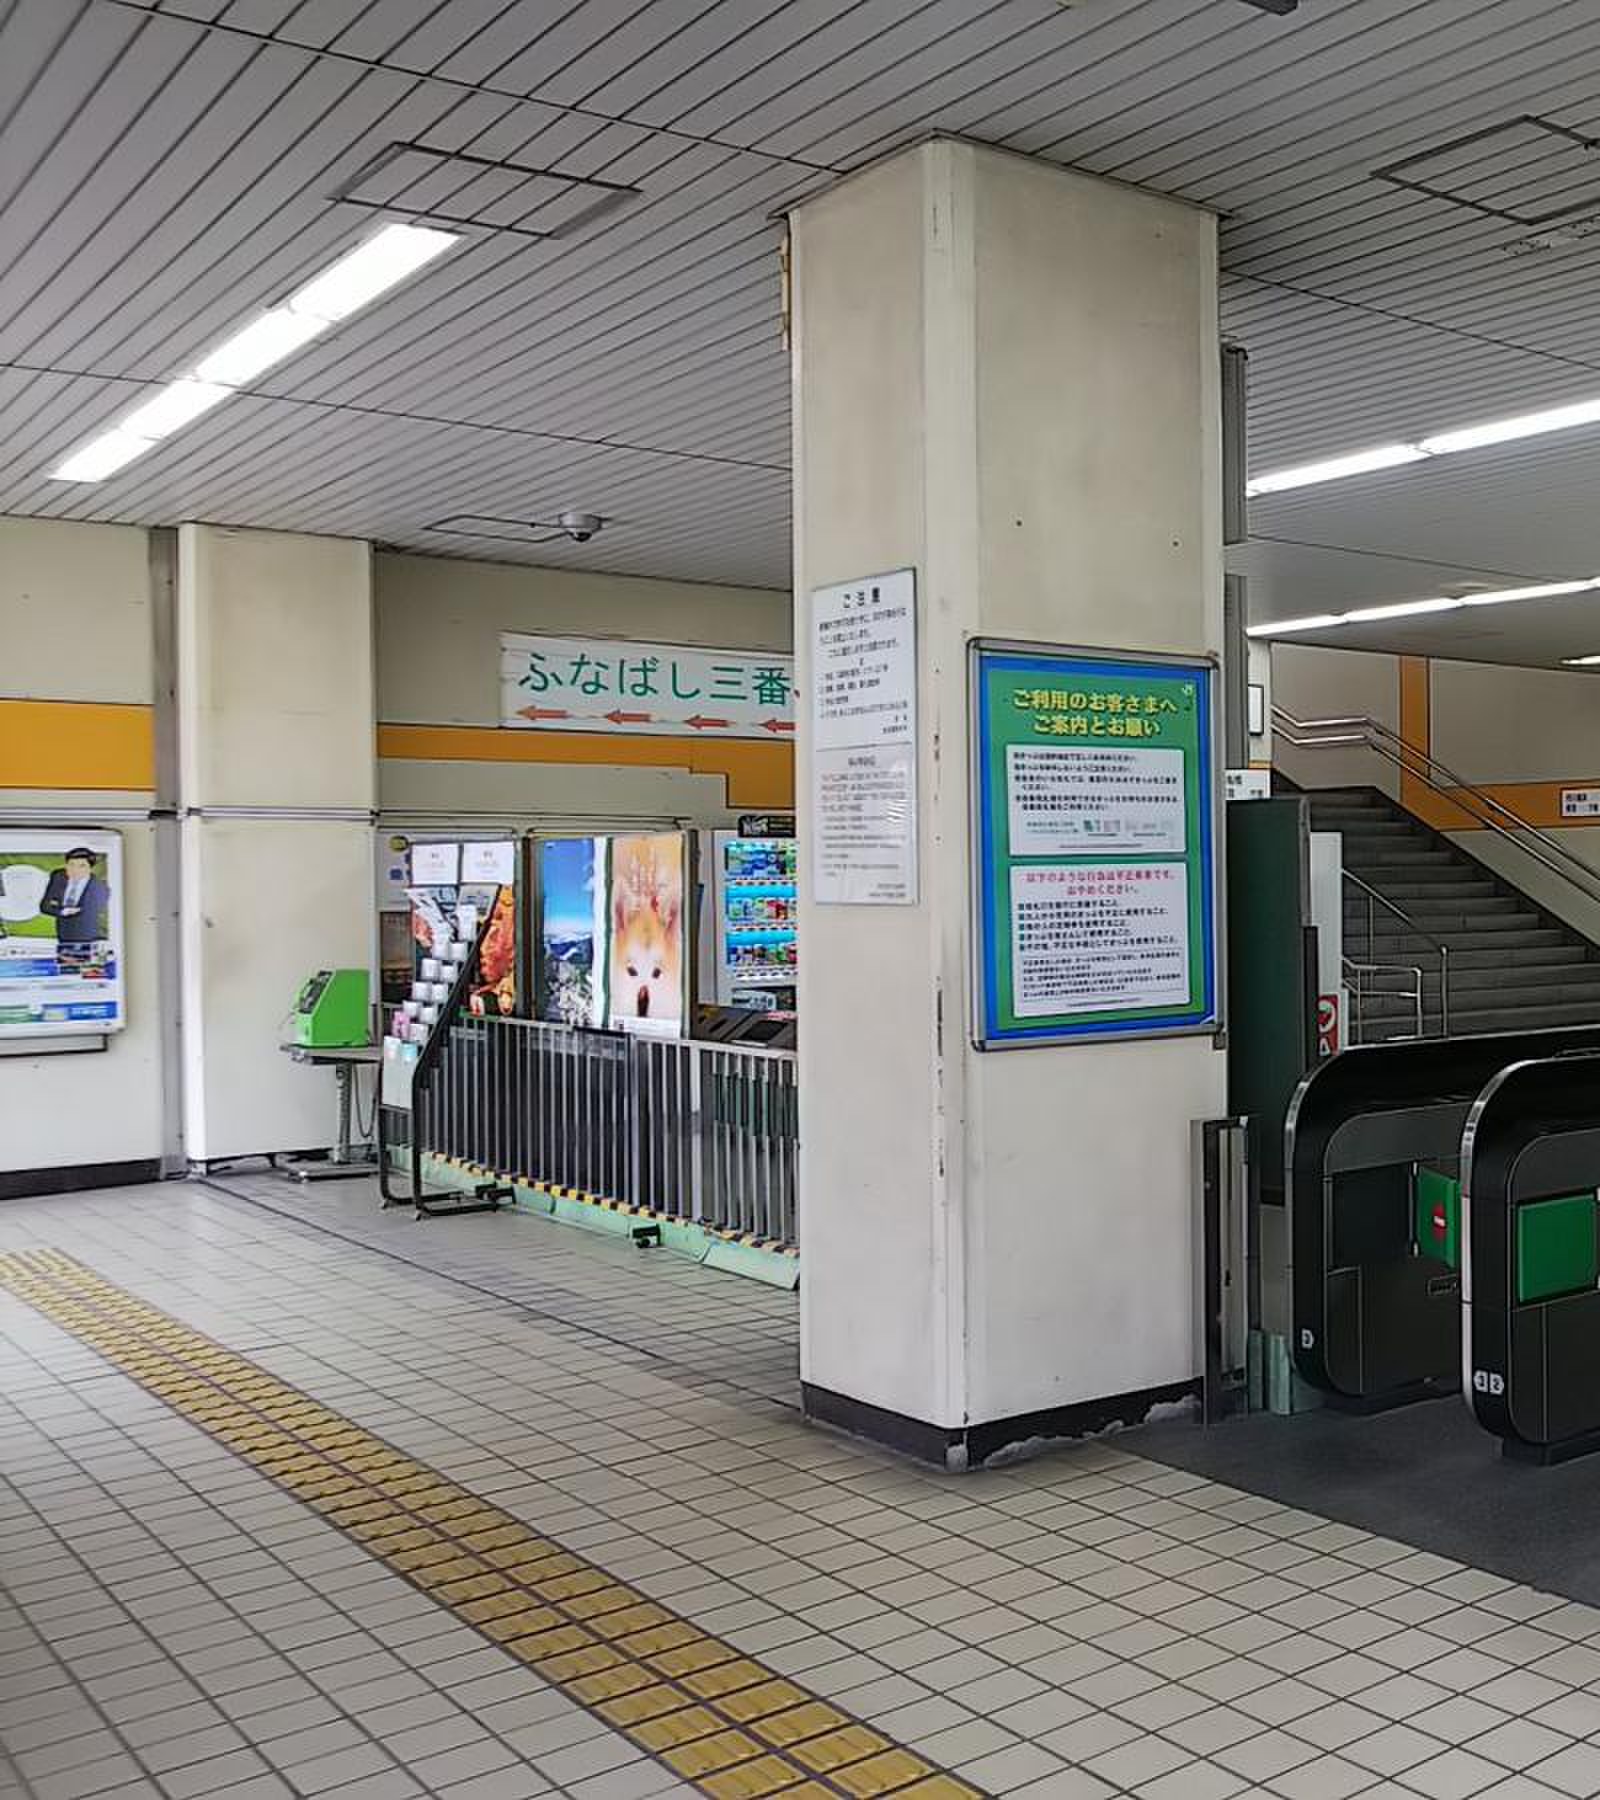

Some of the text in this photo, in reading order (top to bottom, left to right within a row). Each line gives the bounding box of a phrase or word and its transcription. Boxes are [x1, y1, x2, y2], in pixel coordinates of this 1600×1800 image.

[519, 653, 792, 706] ふなばし三番
[1013, 688, 1178, 714] ご利用のお客さまへ
[1033, 714, 1161, 737] ご案内とお願い
